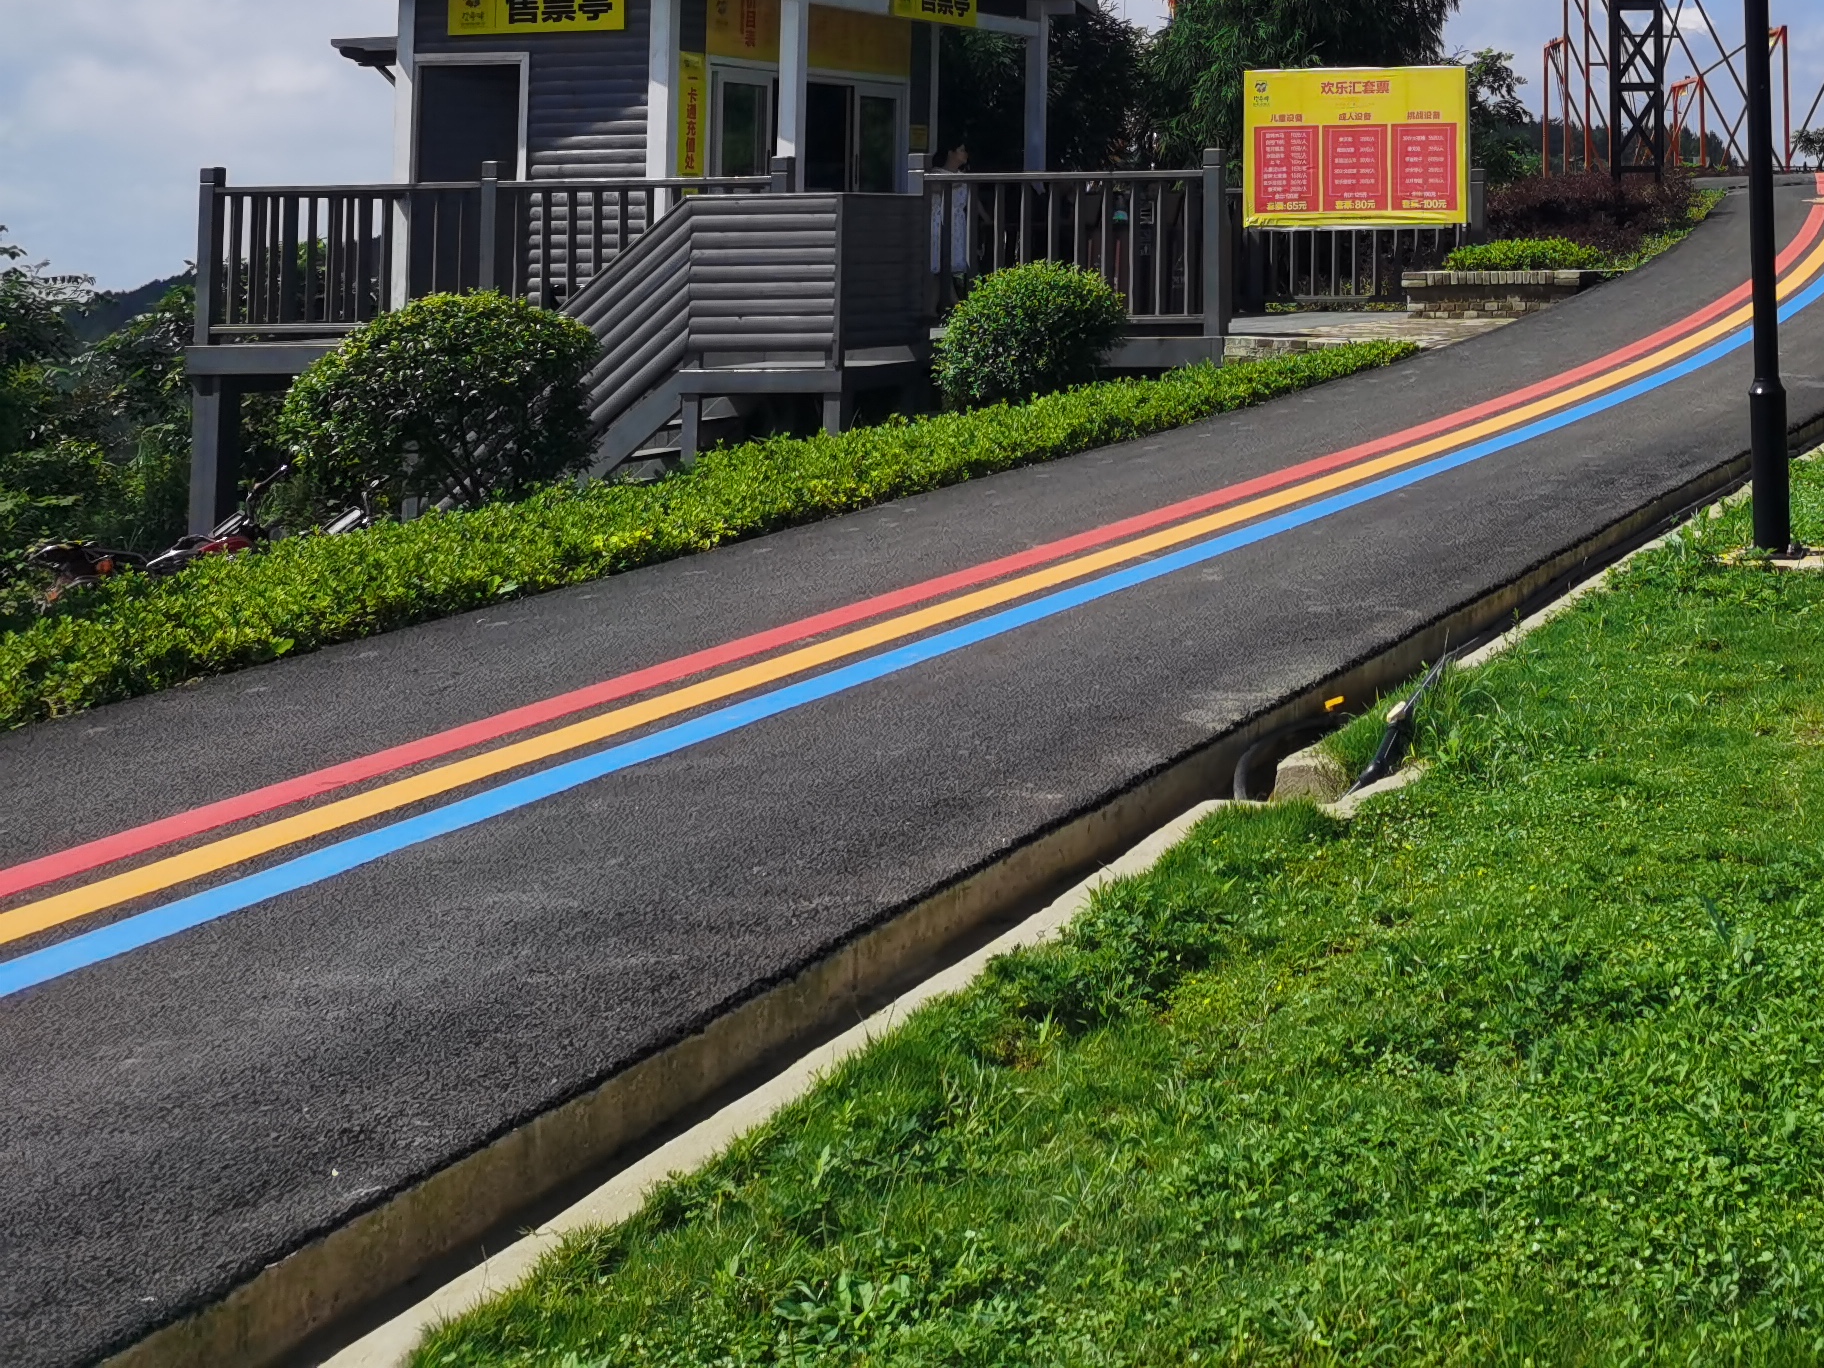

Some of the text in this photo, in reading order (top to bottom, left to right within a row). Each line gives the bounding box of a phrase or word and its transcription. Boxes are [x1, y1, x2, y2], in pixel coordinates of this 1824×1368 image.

[1320, 80, 1390, 94] 欢乐汇套票
[684, 76, 699, 170] 一卡通充值处
[1338, 112, 1372, 121] 成人设备
